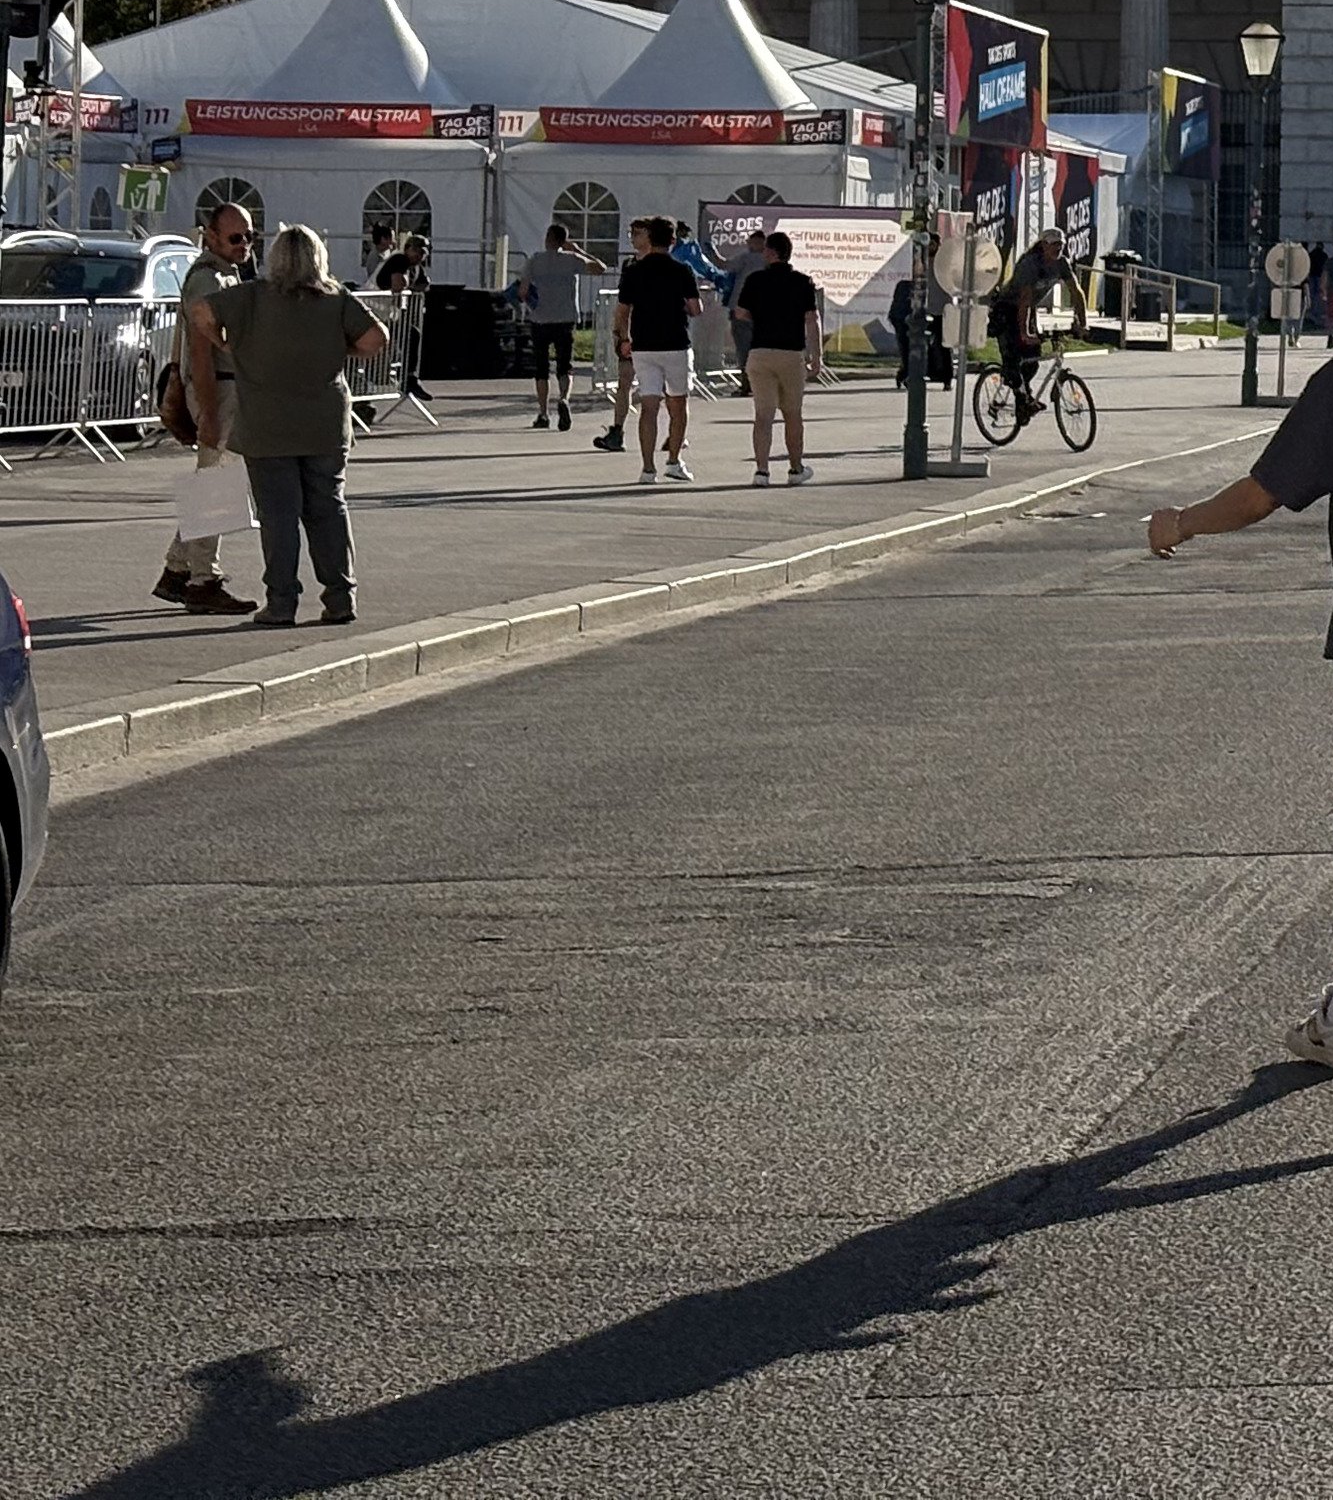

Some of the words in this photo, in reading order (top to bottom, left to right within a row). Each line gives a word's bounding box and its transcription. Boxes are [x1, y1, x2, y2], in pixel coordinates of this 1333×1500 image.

[979, 80, 996, 113] HALL
[996, 76, 1005, 106] OF
[1005, 69, 1026, 104] FAME
[196, 105, 346, 121] LEISTUNGSSPORT
[349, 108, 421, 123] AUSTRIA
[550, 112, 696, 128] LEISTUNGSSPORT
[700, 114, 773, 128] AUSTRIA
[439, 118, 463, 129] TAG
[466, 116, 490, 128] DES
[791, 122, 815, 133] TAG
[818, 120, 842, 132] DES
[441, 127, 489, 138] SPORTS
[793, 131, 842, 143] SPORTS
[976, 190, 991, 225] TAG
[991, 184, 1007, 219] DES
[708, 218, 733, 232] TAG
[736, 216, 764, 231] DES
[710, 231, 756, 246] SPOR
[788, 231, 830, 242] CHTUNG
